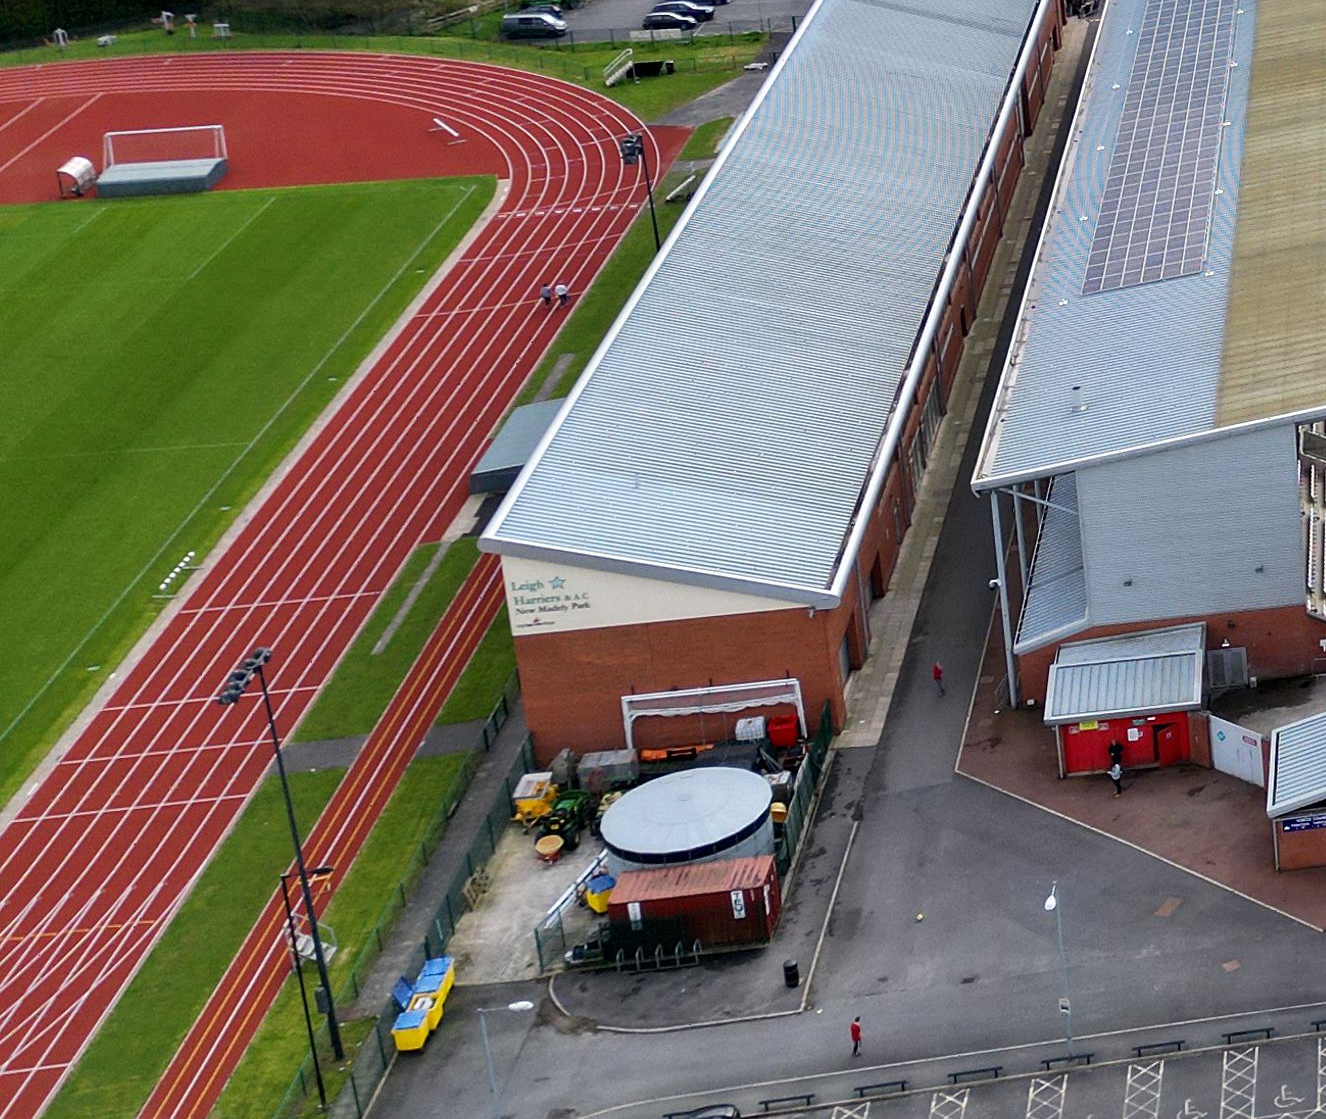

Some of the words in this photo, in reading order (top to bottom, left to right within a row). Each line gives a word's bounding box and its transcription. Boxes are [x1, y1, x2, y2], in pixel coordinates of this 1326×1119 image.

[511, 580, 544, 591] Leigh
[513, 594, 561, 605] Harriers
[571, 602, 590, 610] Park
